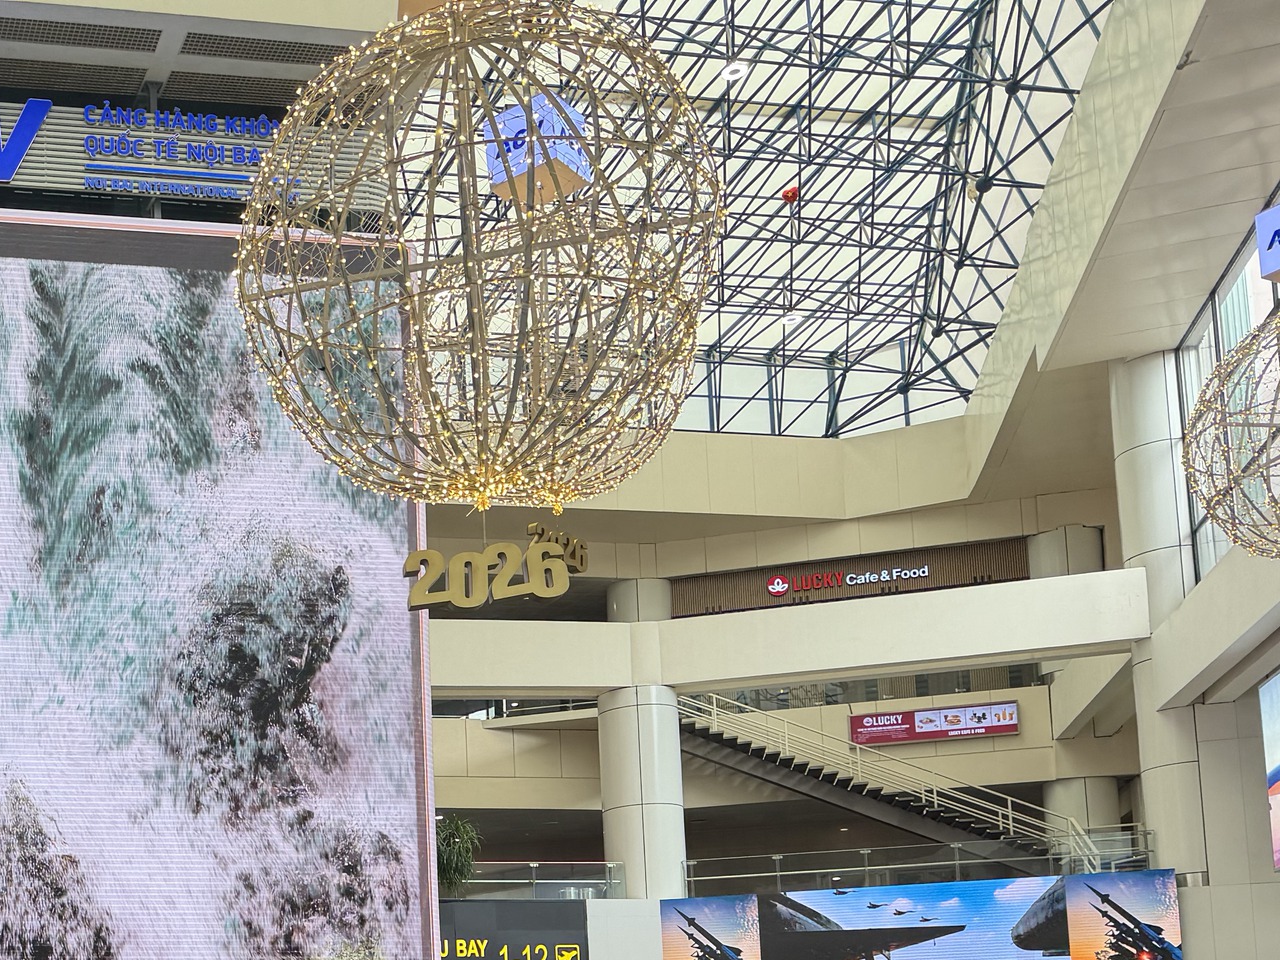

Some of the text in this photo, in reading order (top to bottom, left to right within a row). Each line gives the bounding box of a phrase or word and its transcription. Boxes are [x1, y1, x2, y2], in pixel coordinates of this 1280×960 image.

[83, 100, 280, 138] CẢNG HÀNG KHÔ
[84, 129, 145, 158] QUỐC
[152, 133, 180, 160] TẾ
[187, 140, 225, 168] NỘI
[84, 176, 108, 190] NOI
[111, 178, 134, 191] BAI
[138, 178, 240, 200] INTERNATIONAL
[403, 542, 570, 611] 2026
[792, 570, 844, 591] LUCKY
[846, 573, 879, 585] Cafe
[892, 565, 929, 580] Food
[873, 714, 903, 726] LUCKY
[455, 939, 488, 958] BAY
